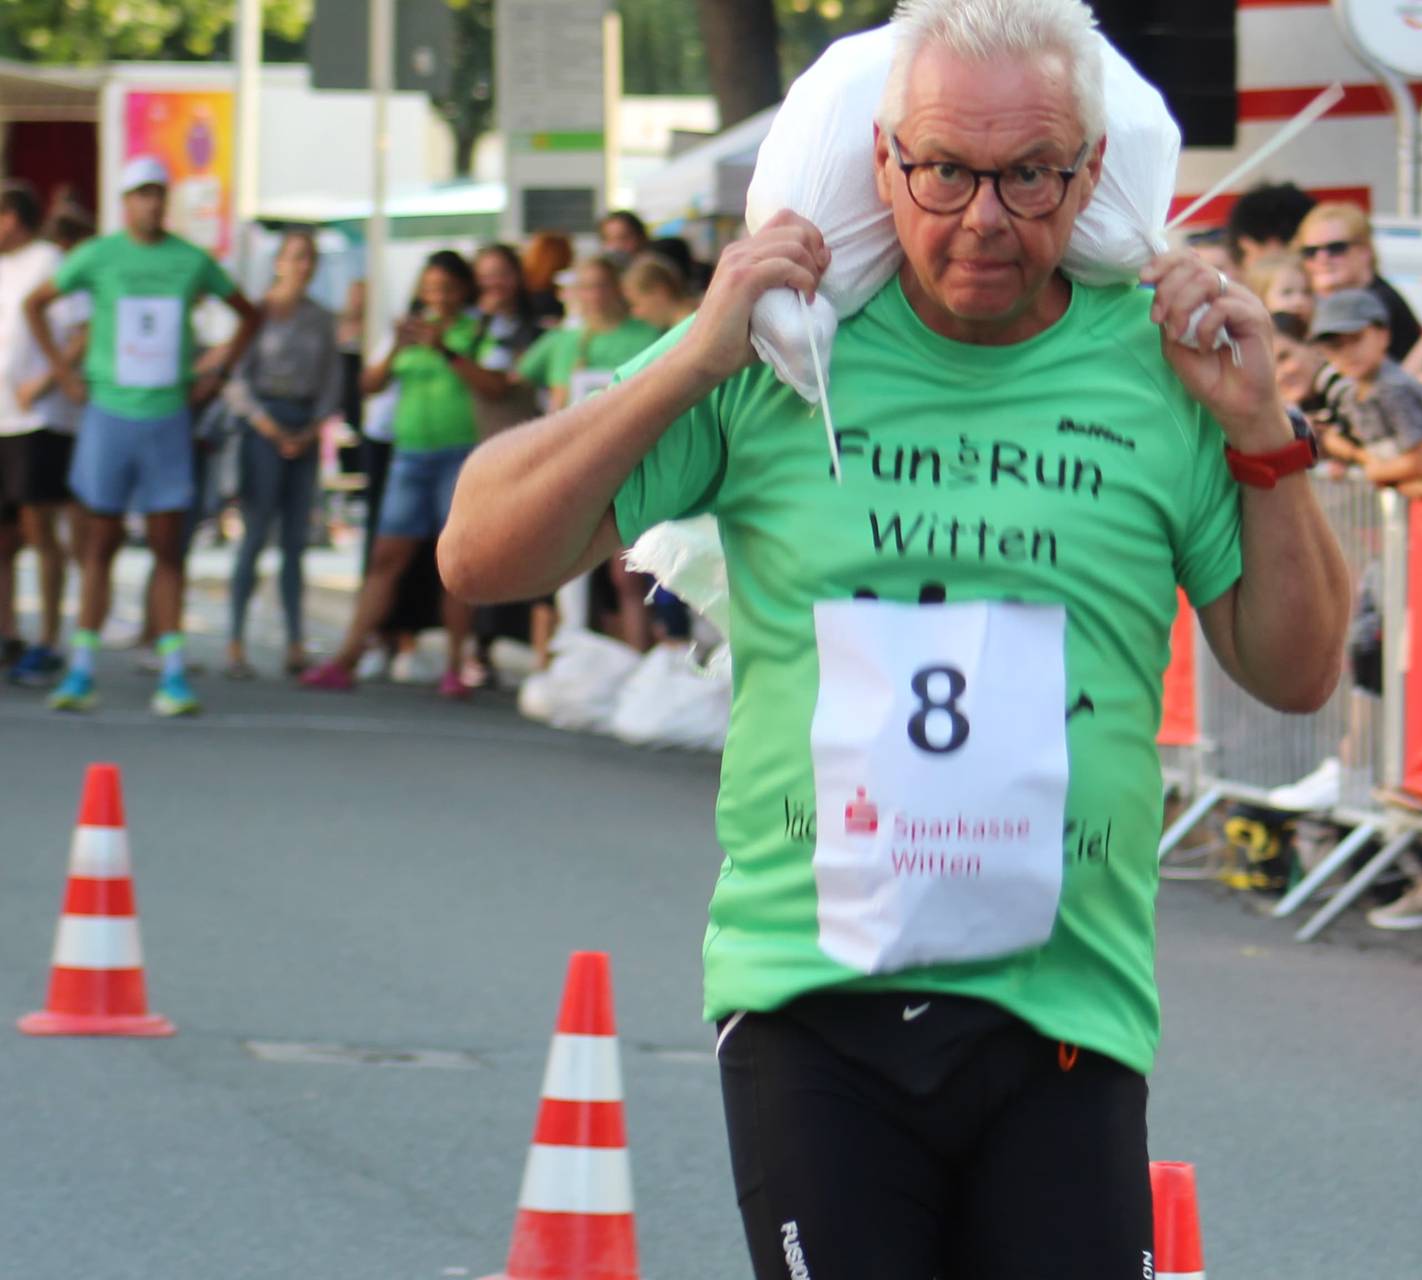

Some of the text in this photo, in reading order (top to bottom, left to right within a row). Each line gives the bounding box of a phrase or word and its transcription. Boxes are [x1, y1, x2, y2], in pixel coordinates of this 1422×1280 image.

[829, 428, 941, 487] Fun
[989, 439, 1103, 499] Run
[868, 508, 1059, 567] Witten
[906, 664, 972, 756] 8
[892, 810, 1031, 844] Sparkasse
[890, 847, 982, 878] Witten
